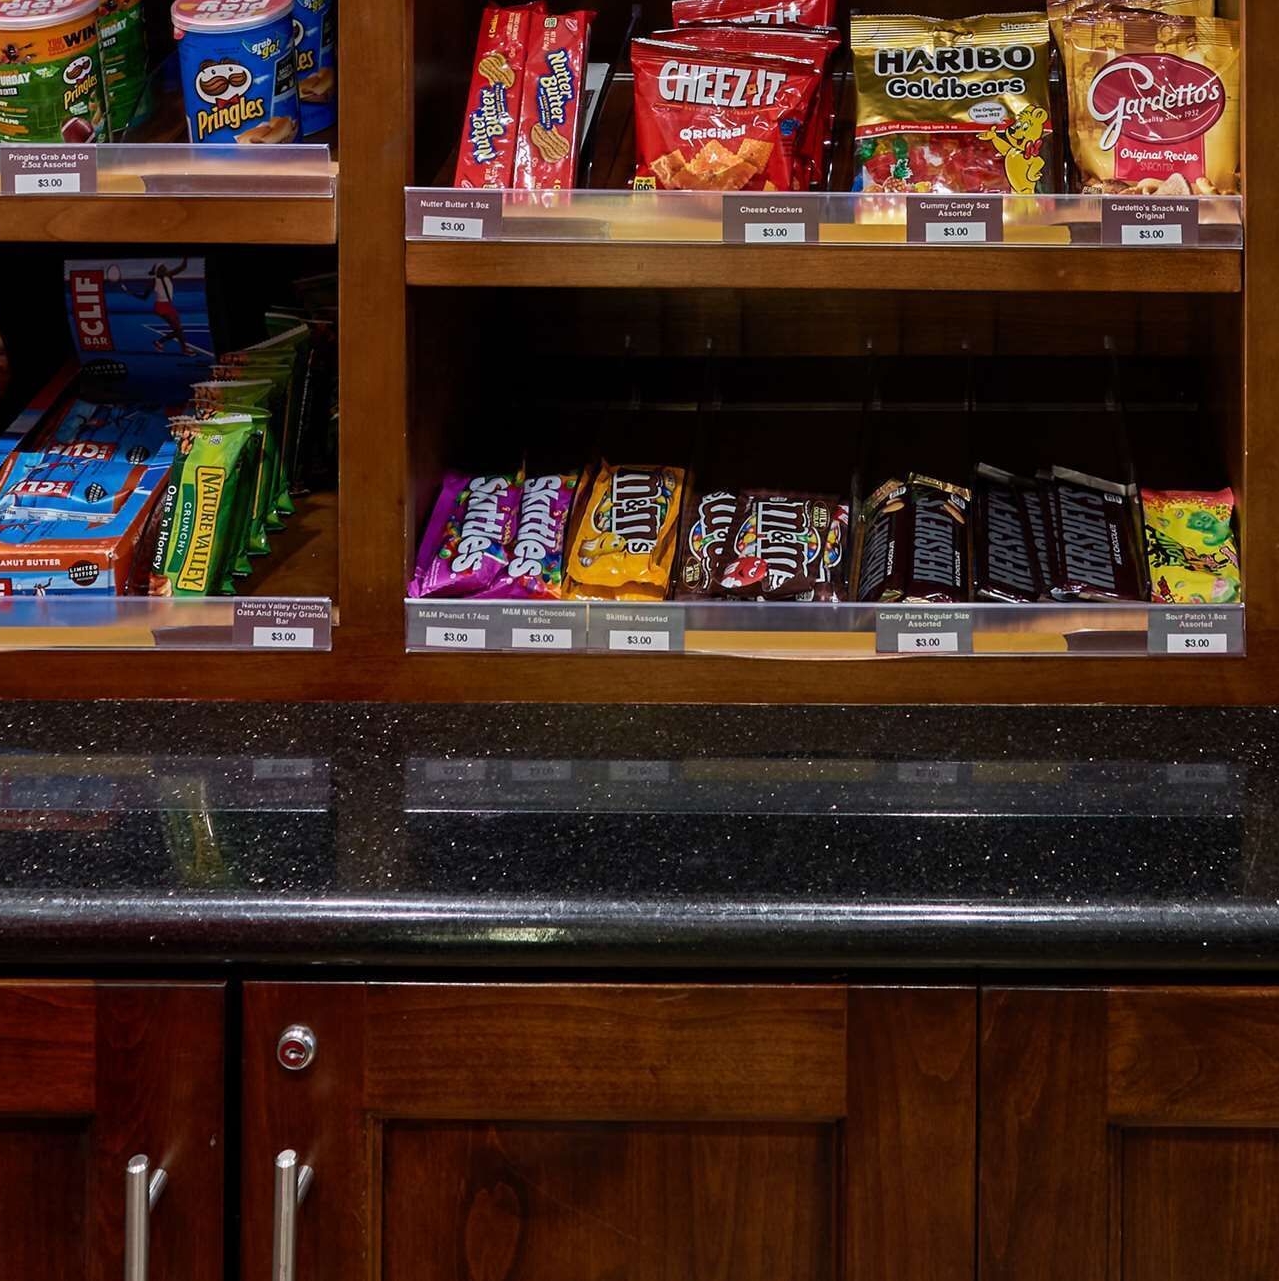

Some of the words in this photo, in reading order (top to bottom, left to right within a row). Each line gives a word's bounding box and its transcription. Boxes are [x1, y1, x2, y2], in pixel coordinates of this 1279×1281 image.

[548, 50, 572, 98] Nutter
[877, 46, 1033, 75] HARIBO
[658, 61, 787, 107] CHEEZ-IT
[887, 78, 1025, 99] Goldbears
[540, 76, 564, 123] Butter
[1088, 62, 1222, 152] Gardetto's
[197, 98, 264, 139] Pringles
[679, 124, 746, 140] ORIGINAL
[9, 153, 37, 162] Pringles
[40, 153, 59, 161] Grab
[22, 161, 40, 169] 2.5oz
[43, 161, 77, 169] Assorted
[1120, 149, 1161, 163] Original
[1164, 150, 1199, 162] Recipe
[38, 179, 62, 189] $3.00
[740, 206, 765, 214] Cheese
[762, 228, 788, 238] $3.00
[79, 275, 105, 336] CLIF
[83, 336, 109, 346] BAR
[165, 485, 176, 512] Oats
[201, 472, 222, 531] NATURE
[161, 518, 172, 527] 'n
[177, 502, 192, 555] CRUNCHY
[452, 476, 509, 573] Skittles
[27, 558, 61, 566] BUTTER
[153, 531, 169, 569] Honey
[182, 533, 212, 587] VALLEY
